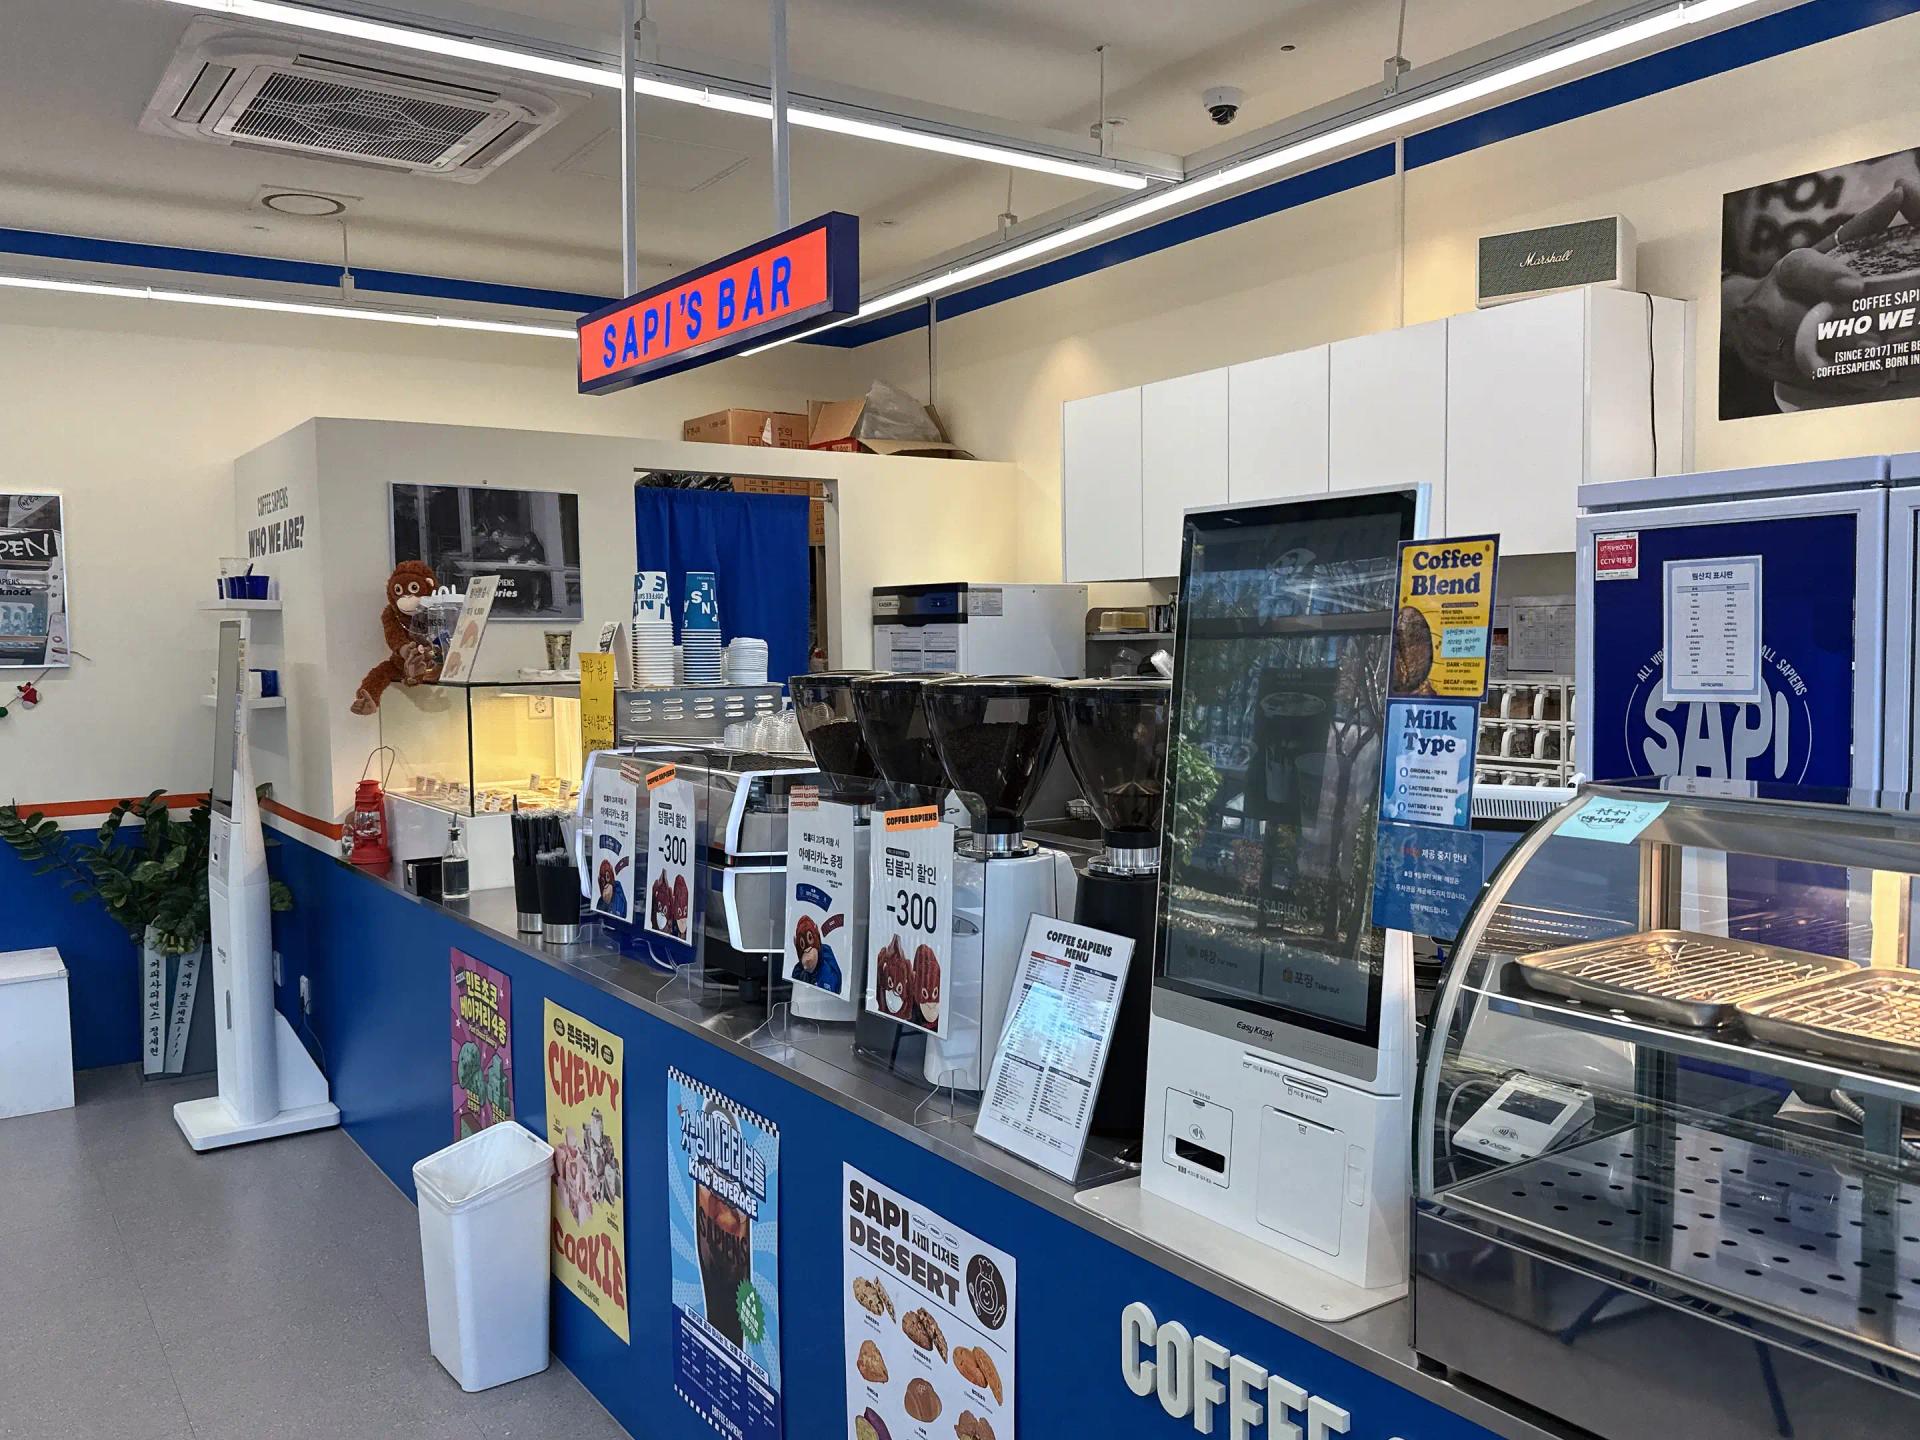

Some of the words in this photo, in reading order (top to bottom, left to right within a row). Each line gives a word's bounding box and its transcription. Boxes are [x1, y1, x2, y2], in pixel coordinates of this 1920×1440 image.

[1520, 250, 1574, 268] Marshall
[603, 290, 702, 368] SAPI'S
[718, 256, 791, 330] BAR
[1853, 293, 1892, 312] COFFEE
[1818, 315, 1872, 340] WHO
[1879, 308, 1916, 331] WE
[1835, 348, 1862, 363] [SINCE
[1864, 344, 1891, 359] 2017]
[1893, 341, 1909, 355] THE
[1817, 360, 1884, 378] COFFEESAPIENS,
[1885, 354, 1909, 369] BORN
[248, 526, 267, 558] WHO
[268, 521, 281, 554] WE
[282, 515, 305, 551] ARE?
[1413, 550, 1482, 570] Coffee
[1411, 572, 1480, 596] Blend
[1692, 572, 1711, 580] 원산지
[1713, 571, 1733, 579] 표시판
[1637, 665, 1653, 682] ALL
[1761, 643, 1774, 663] ALL
[1776, 659, 1807, 696] SAPIENS
[1404, 709, 1457, 731] Milk
[1643, 674, 1790, 781] SAPI
[1403, 732, 1456, 757] Type
[658, 810, 675, 827] 텀블러
[675, 812, 687, 829] 할인
[886, 816, 909, 826] COFFEE
[910, 812, 938, 823] SAPIENS
[658, 833, 687, 867] -300
[798, 847, 829, 866] 아메리카노
[830, 854, 843, 870] 증정
[1453, 852, 1468, 864] 안내
[886, 858, 914, 880] 텀블러
[916, 863, 937, 886] 할인
[886, 889, 937, 934] -300
[1047, 930, 1076, 947] COFFEE
[1076, 938, 1113, 957] SAPIENS
[1064, 947, 1090, 963] MENU
[465, 970, 498, 1011] 민트초코
[1295, 971, 1313, 988] 포장
[459, 995, 490, 1032] 베이커리
[491, 1013, 506, 1046] 4종
[548, 1040, 619, 1112] CHEWY
[713, 1174, 758, 1217] BEVERAGE
[850, 1180, 909, 1242] SAPI
[553, 1216, 625, 1311] COOKIE
[850, 1215, 960, 1307] DESSERT
[912, 1230, 929, 1254] 사피
[931, 1241, 959, 1272] 디저트
